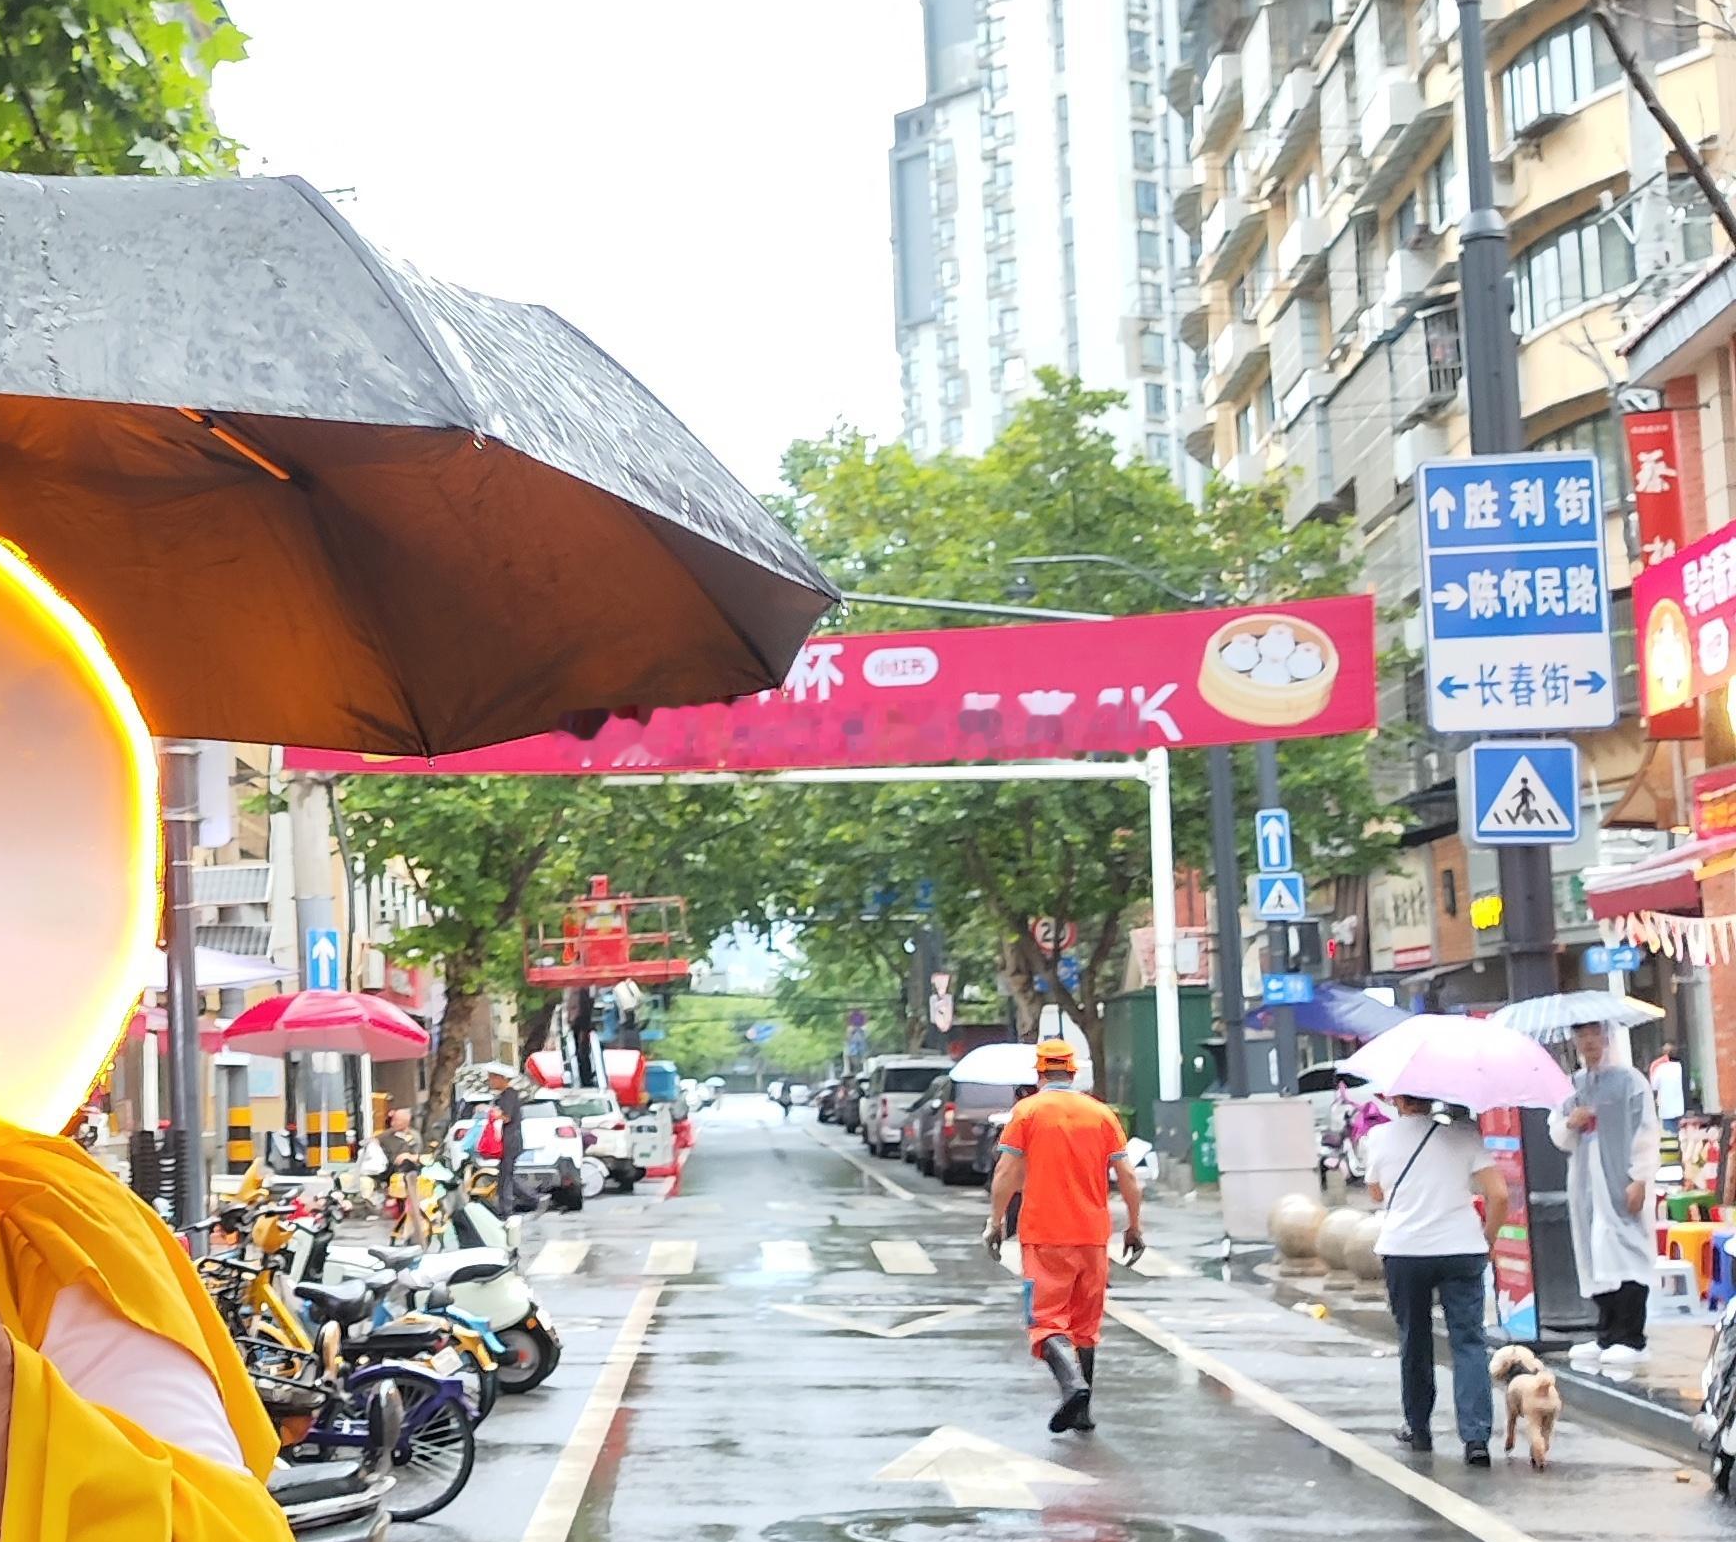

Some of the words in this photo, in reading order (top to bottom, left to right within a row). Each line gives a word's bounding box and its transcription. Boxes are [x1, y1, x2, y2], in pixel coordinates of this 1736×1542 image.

[1464, 476, 1592, 530] 胜利街
[1467, 564, 1599, 620] 陈怀民路
[875, 659, 927, 676] 小红书
[1475, 662, 1571, 708] 长春街
